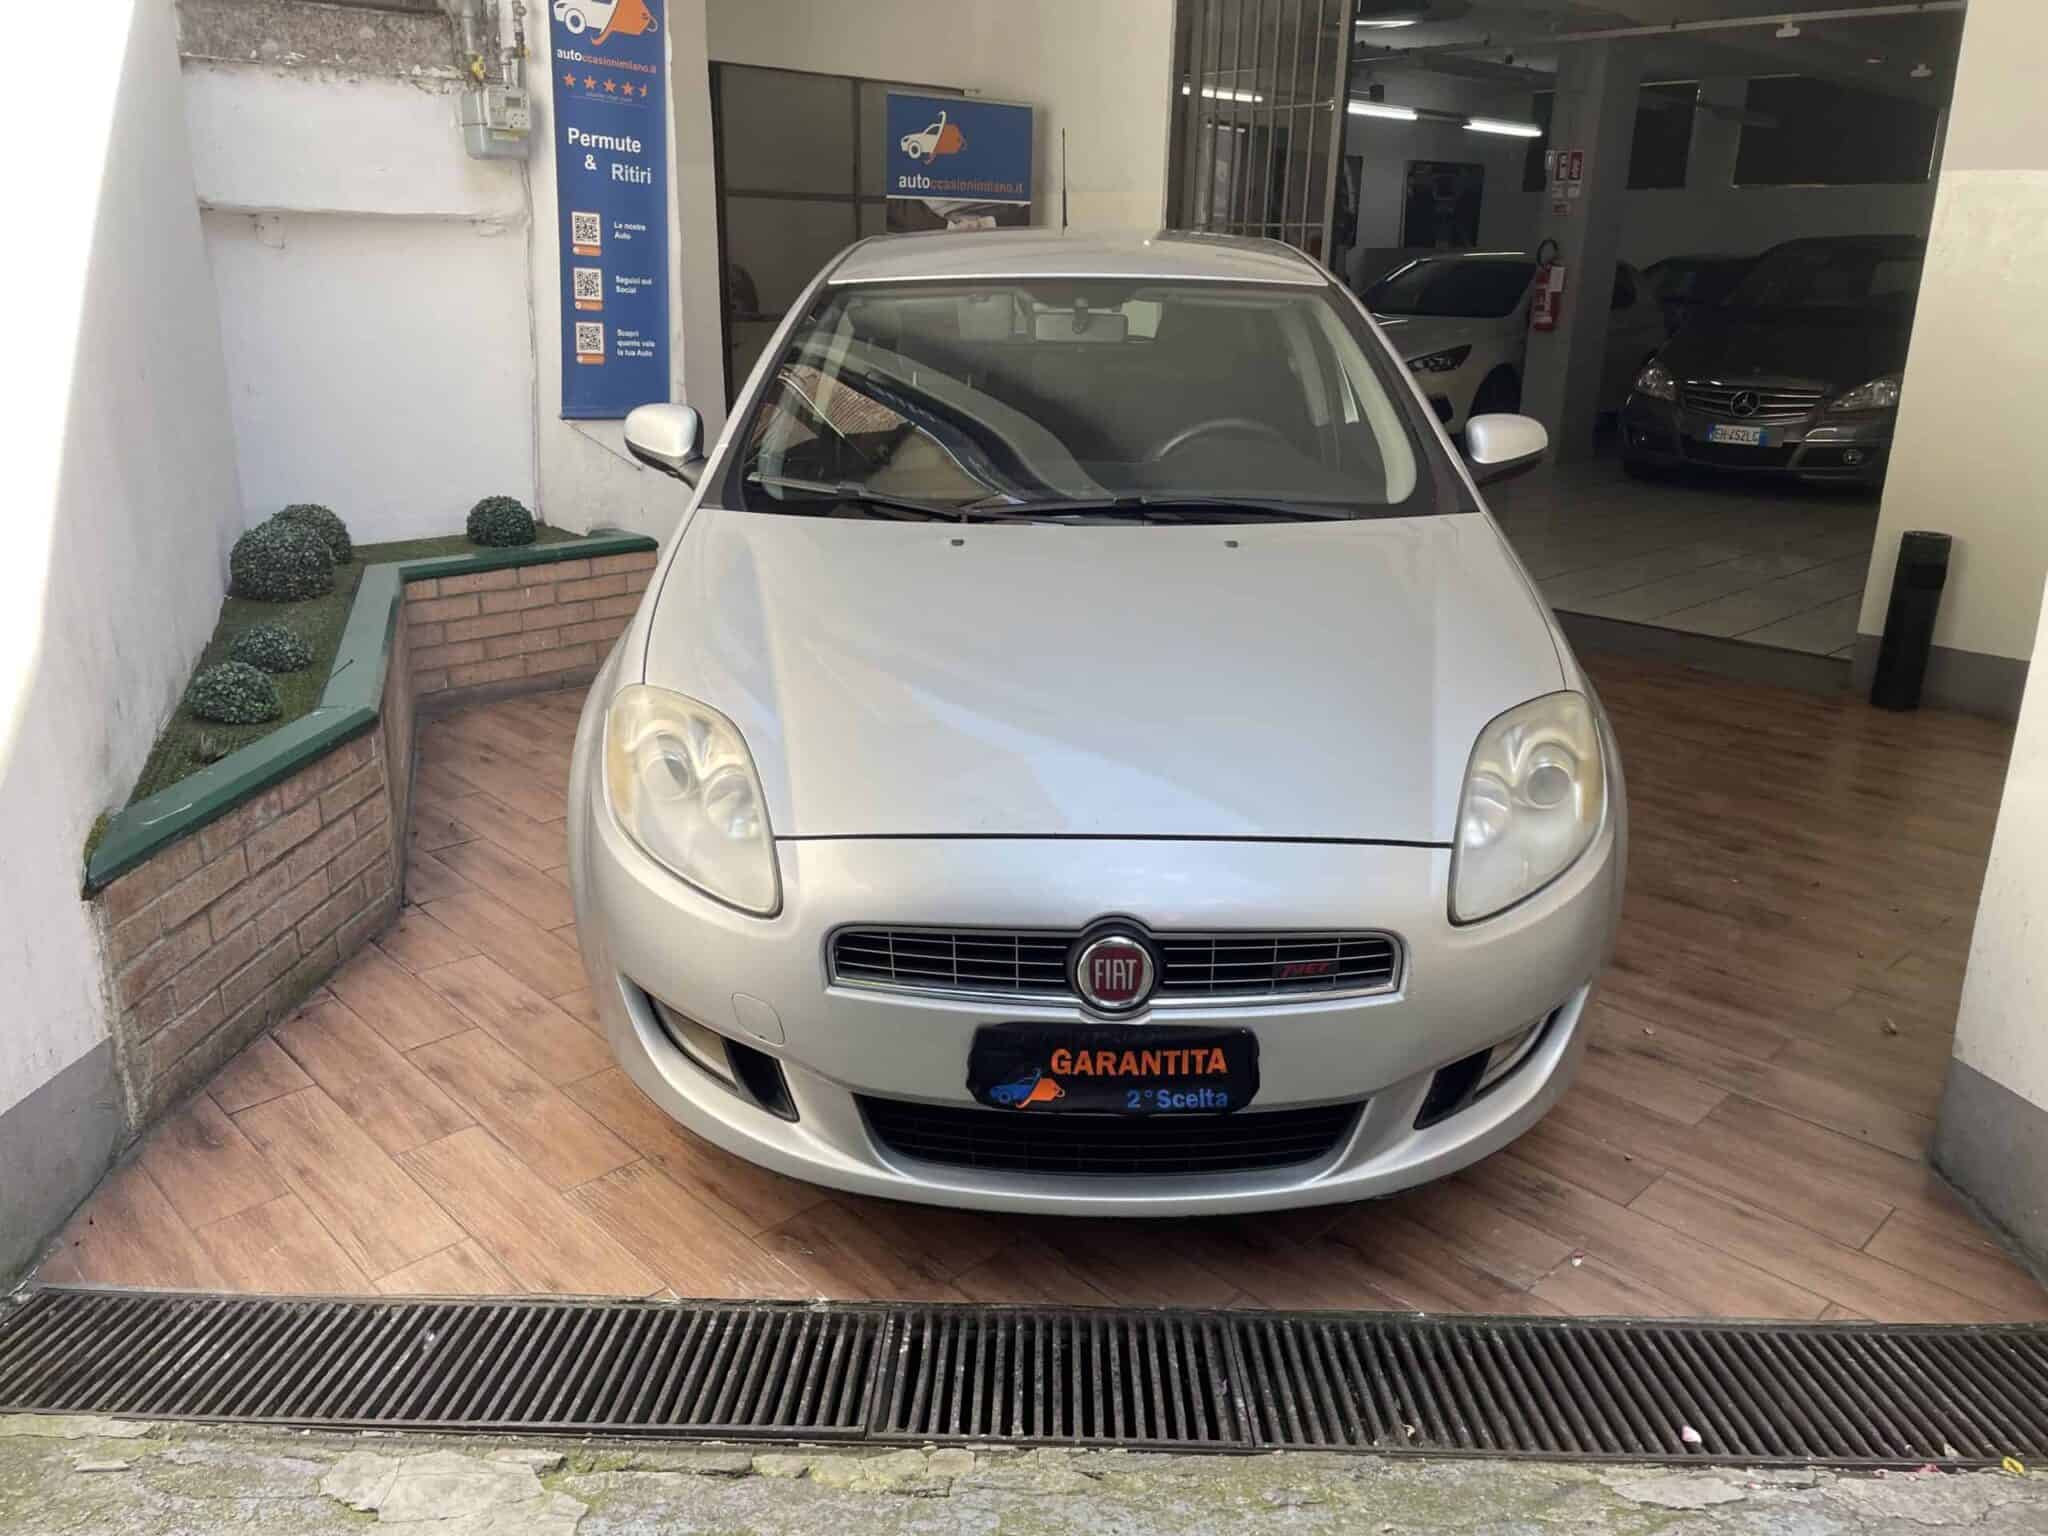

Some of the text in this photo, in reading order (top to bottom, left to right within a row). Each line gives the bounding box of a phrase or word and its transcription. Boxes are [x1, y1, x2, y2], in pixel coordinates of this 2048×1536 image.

[567, 127, 641, 153] Permute
[584, 153, 652, 184] & Ritiri
[1094, 957, 1138, 991] FIAT
[1050, 1047, 1228, 1077] GARANTITA
[1158, 1088, 1229, 1109] Scelta
